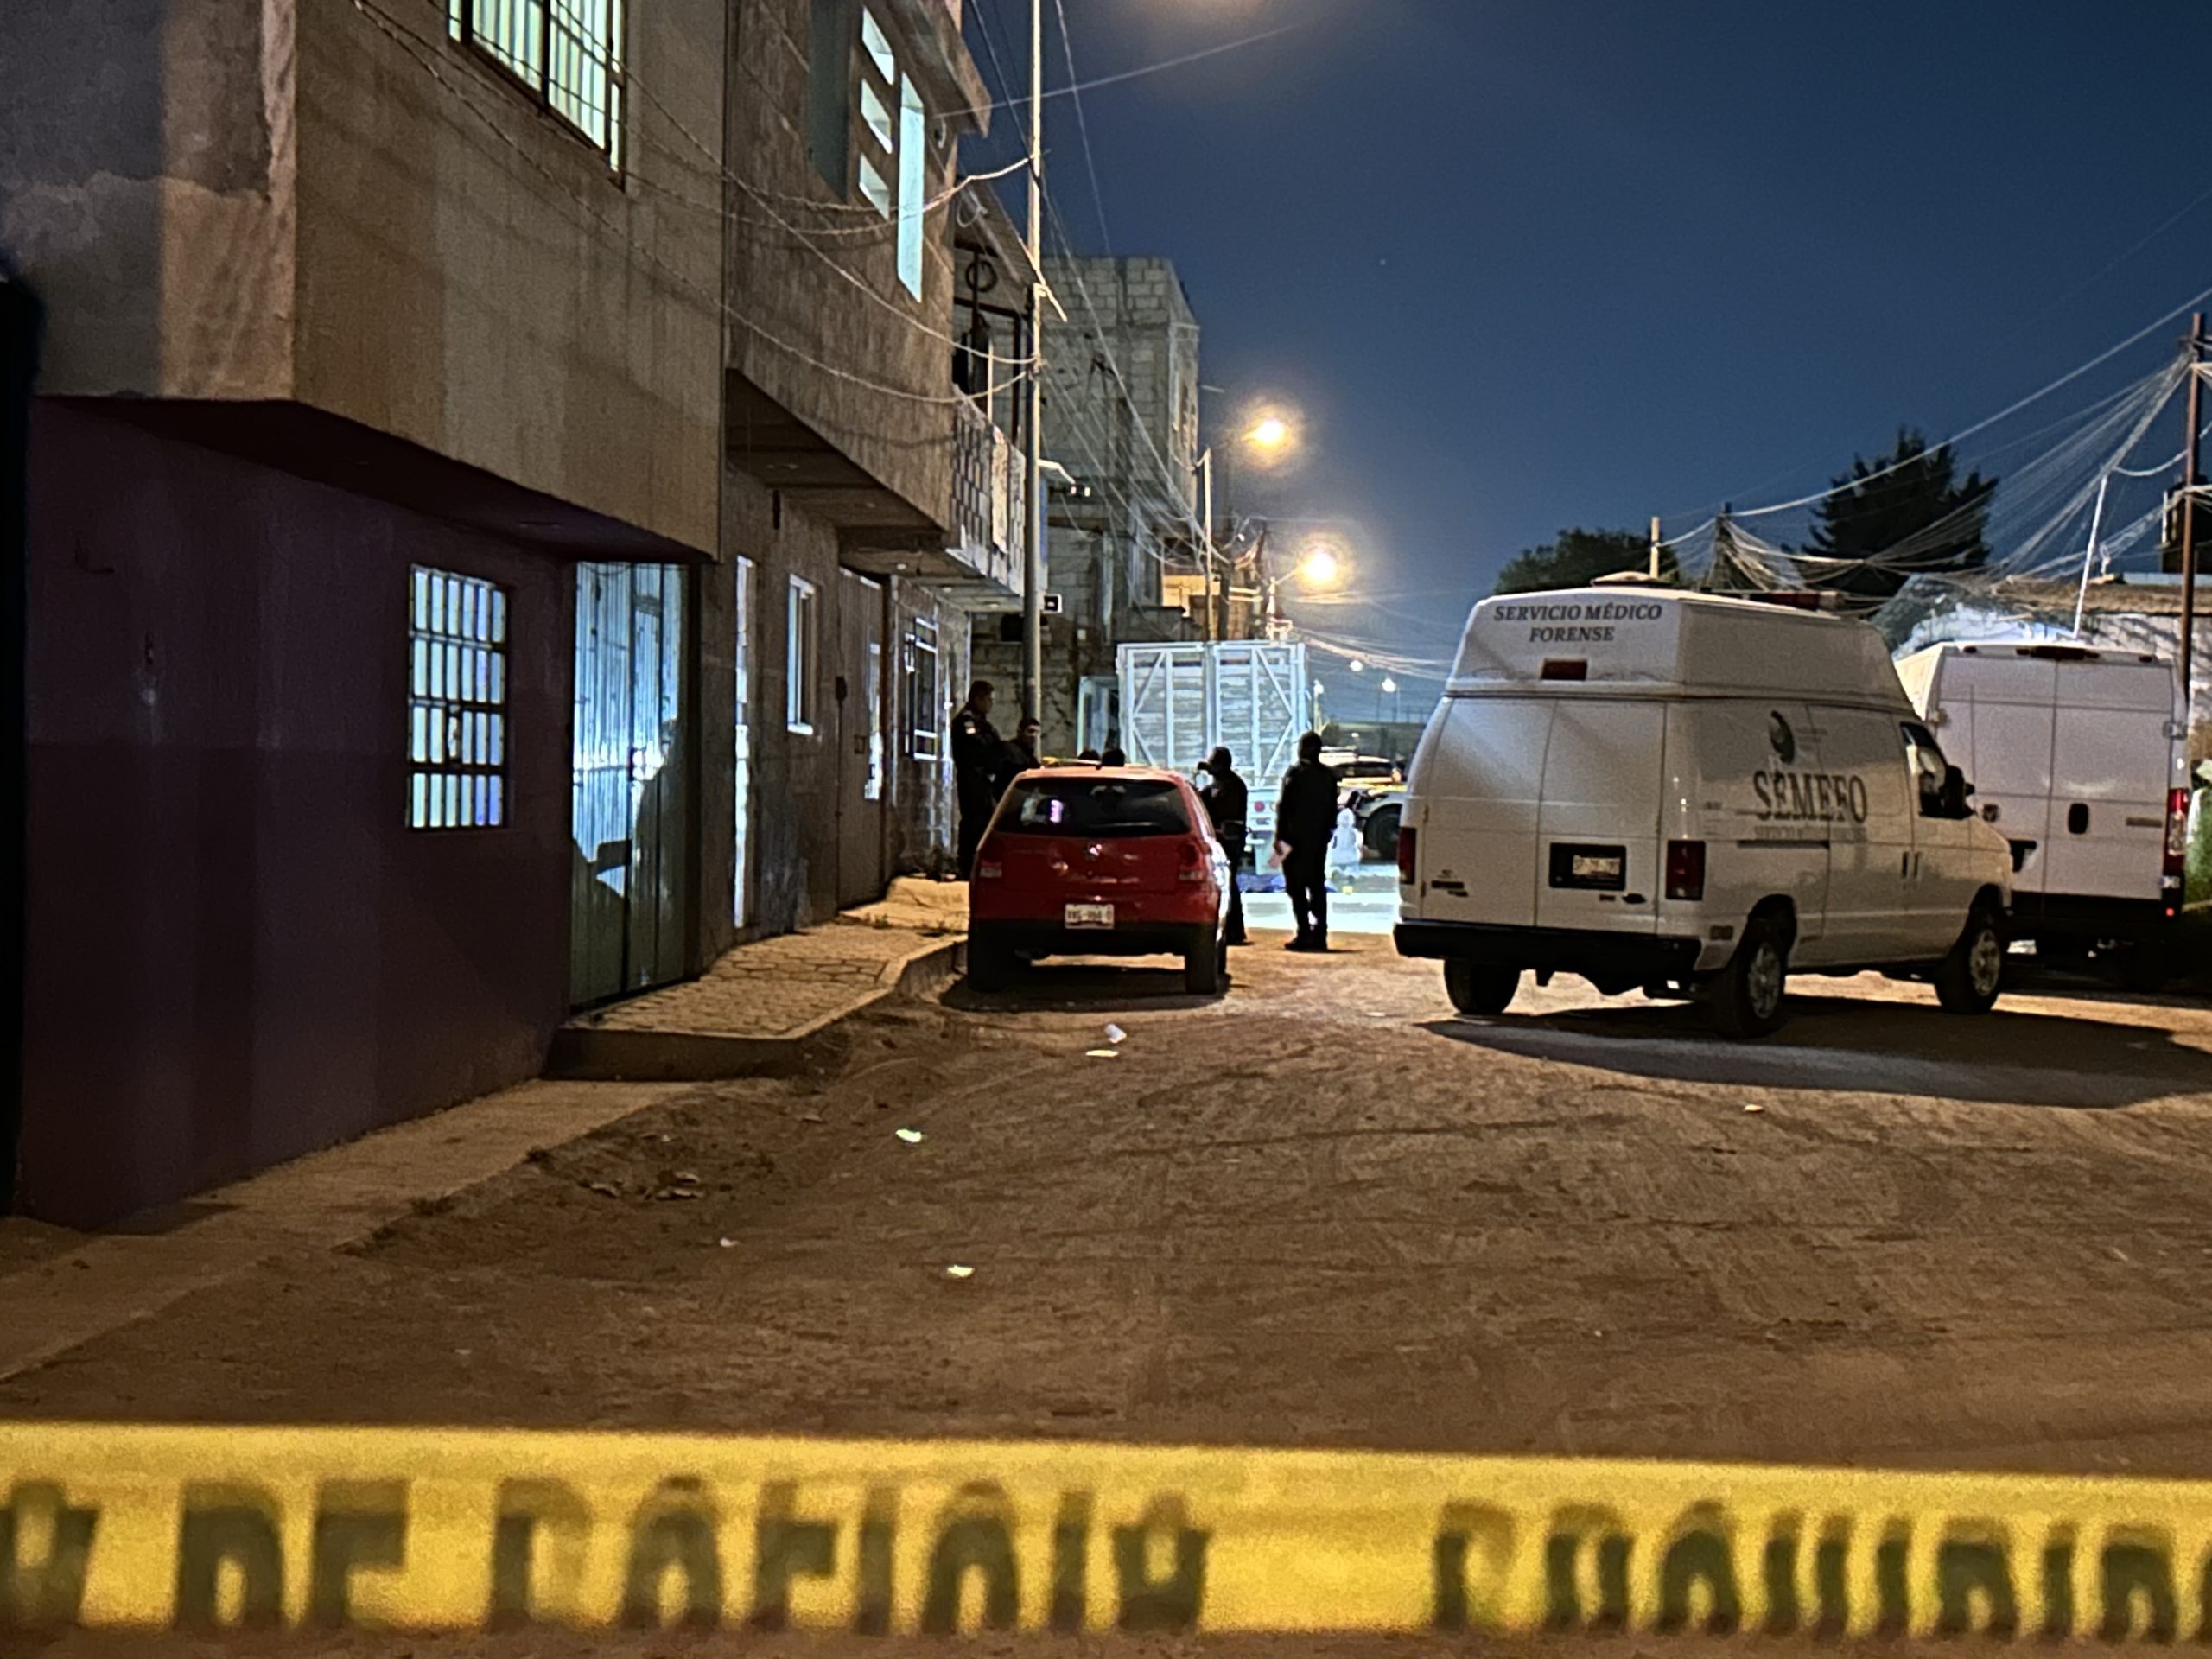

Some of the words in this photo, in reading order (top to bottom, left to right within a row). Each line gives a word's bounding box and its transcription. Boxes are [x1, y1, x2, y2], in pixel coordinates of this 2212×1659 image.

[1493, 604, 1581, 621] SERVICIO
[1585, 602, 1662, 621] MÉDICO
[1529, 626, 1615, 643] FORENSE
[1752, 770, 1867, 823] SEMEFO
